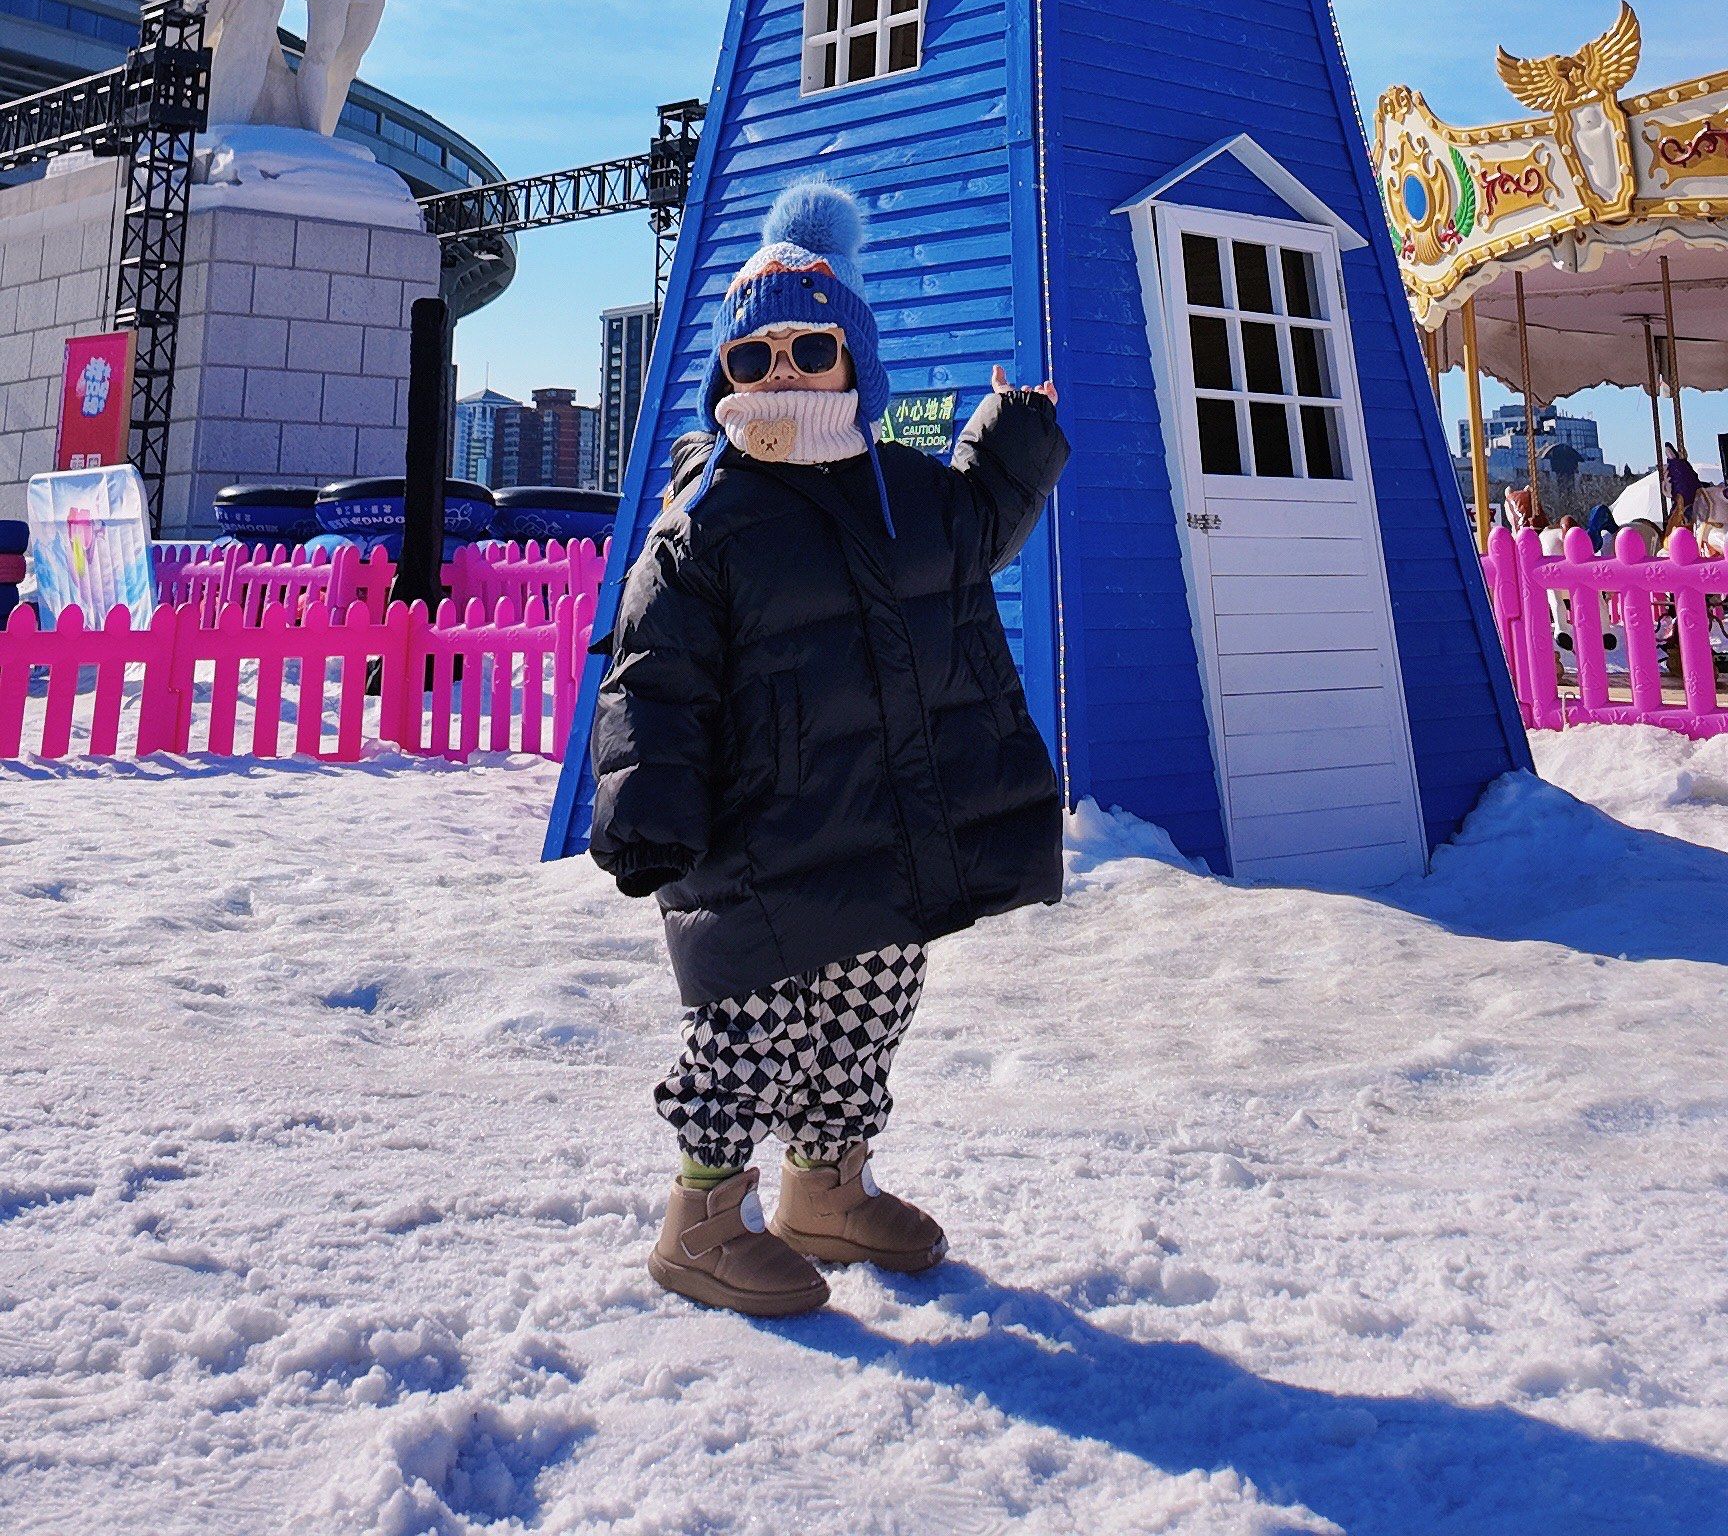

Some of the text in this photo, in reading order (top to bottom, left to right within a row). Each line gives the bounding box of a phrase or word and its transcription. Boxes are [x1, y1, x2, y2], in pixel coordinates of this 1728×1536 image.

[896, 395, 954, 423] 小心地滑
[902, 424, 941, 436] CAUTION
[916, 435, 948, 446] FLOOR
